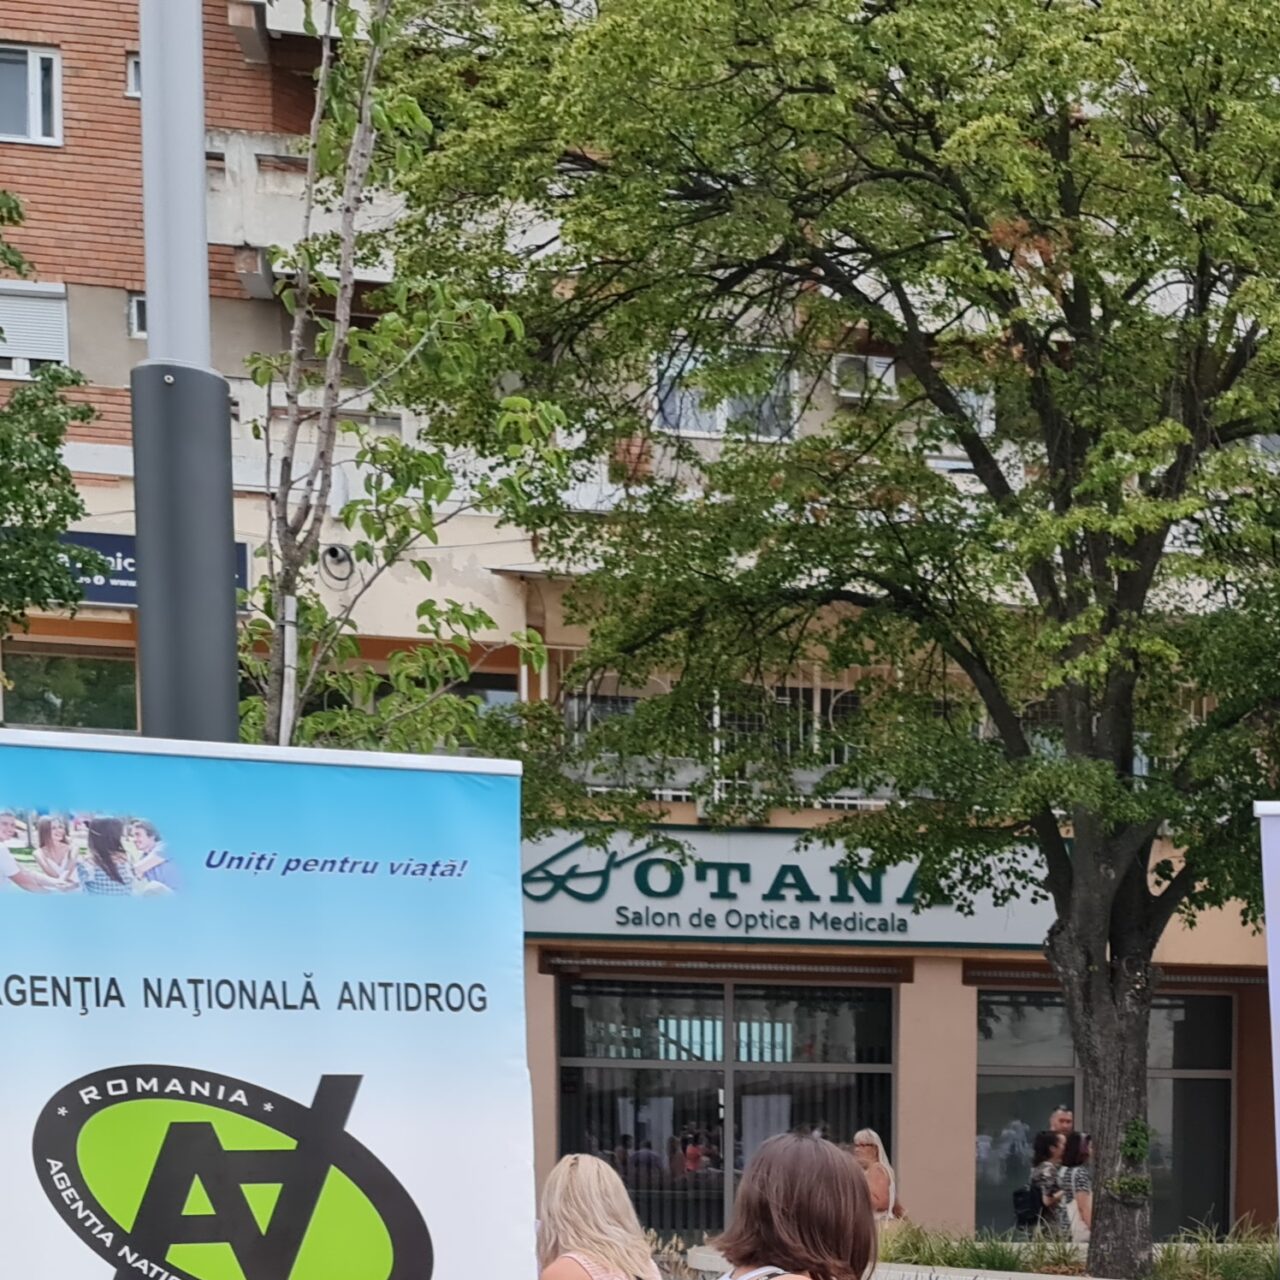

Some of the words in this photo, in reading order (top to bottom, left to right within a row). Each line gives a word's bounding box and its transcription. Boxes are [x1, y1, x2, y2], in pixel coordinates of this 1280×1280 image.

[281, 855, 380, 877] pentru
[615, 905, 681, 928] Salon
[688, 907, 717, 929] de
[724, 908, 801, 934] Optica
[809, 911, 909, 934] Medicala
[0, 973, 126, 1016] GENŢIA
[337, 980, 488, 1013] ANTIDROG
[79, 1076, 249, 1107] ROMANIA
[46, 1157, 115, 1249] AGENTIA
